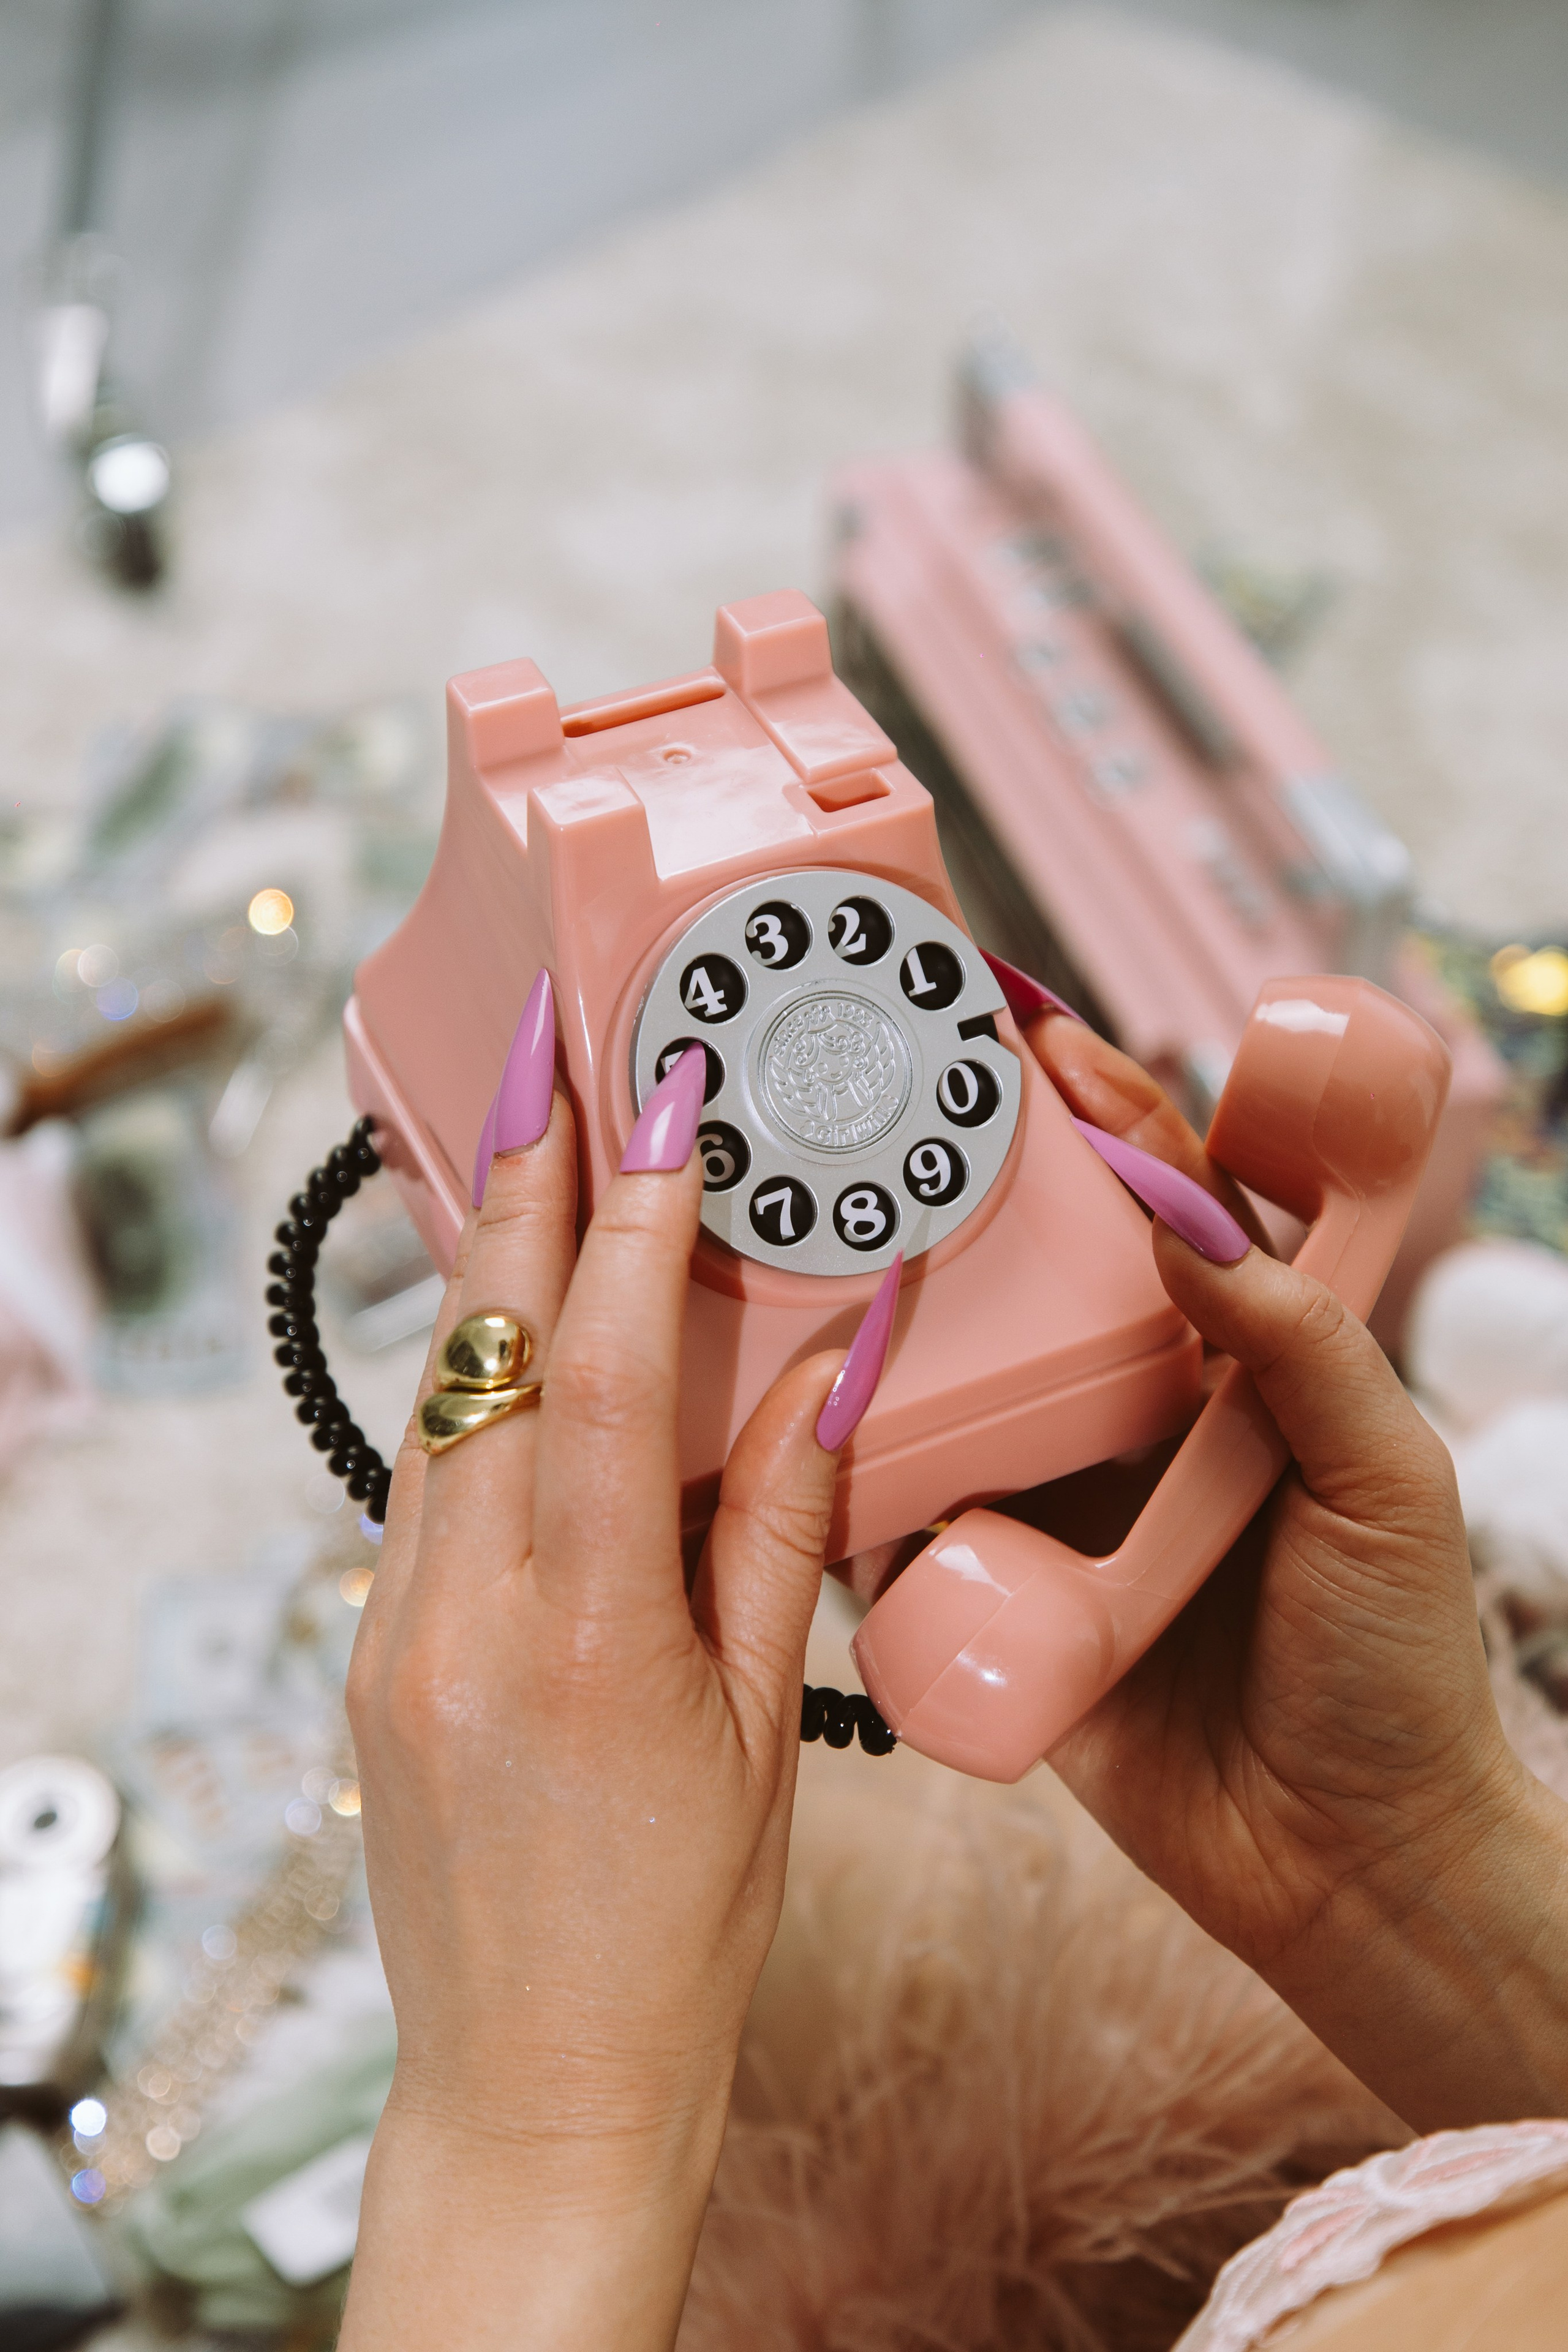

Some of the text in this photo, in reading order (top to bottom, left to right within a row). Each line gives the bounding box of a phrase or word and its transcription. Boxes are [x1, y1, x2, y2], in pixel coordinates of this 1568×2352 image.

[745, 914, 789, 967] 3
[827, 907, 866, 957] 2
[684, 967, 728, 1017] 4
[905, 947, 937, 997] 1
[774, 1014, 804, 1057] since
[938, 1061, 978, 1114] 0
[696, 1133, 735, 1183] 6
[910, 1144, 951, 1196] 9
[754, 1186, 796, 1240] 7
[840, 1190, 886, 1242] 8
